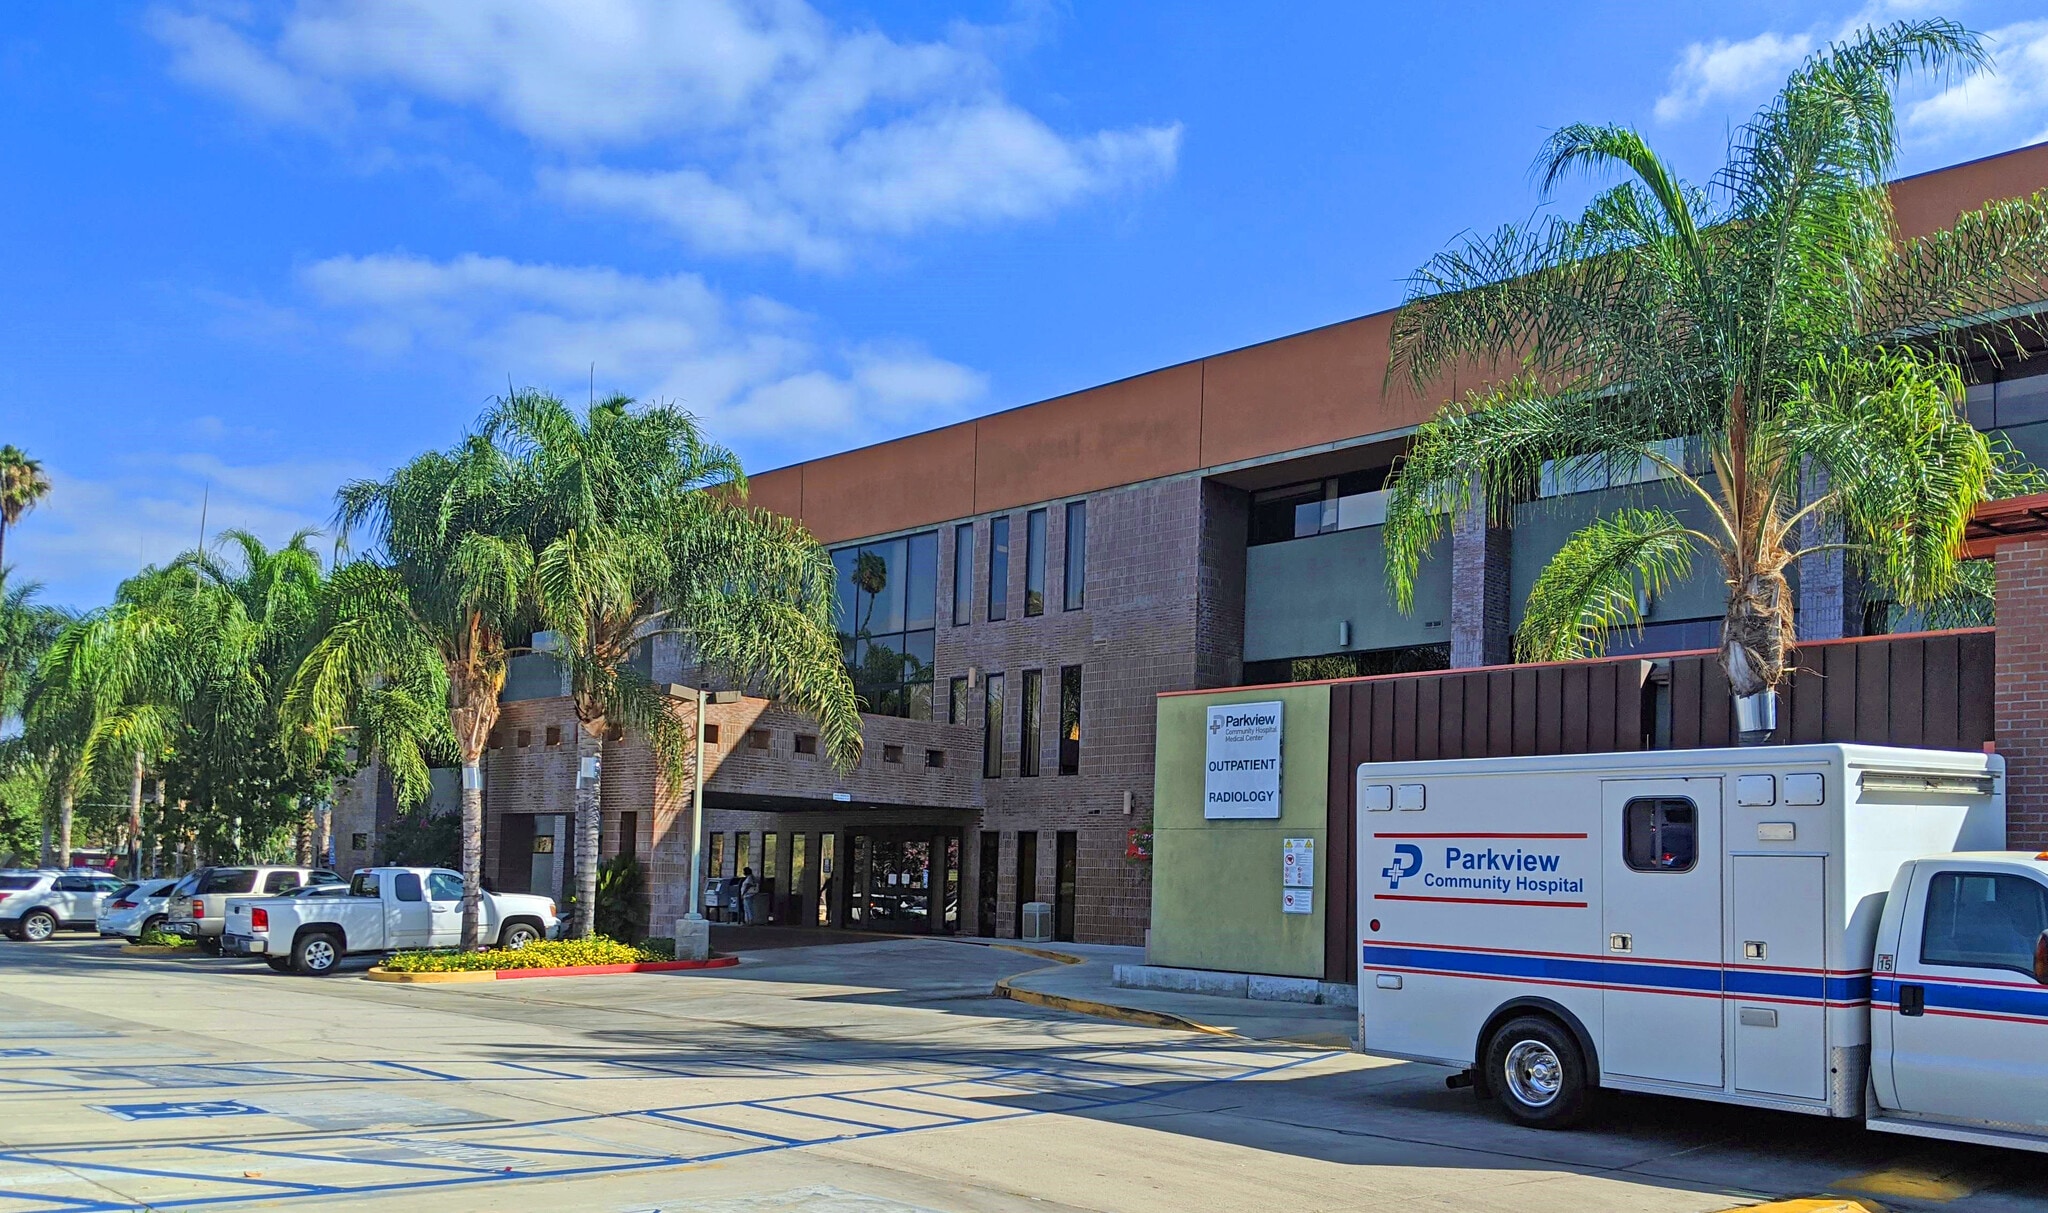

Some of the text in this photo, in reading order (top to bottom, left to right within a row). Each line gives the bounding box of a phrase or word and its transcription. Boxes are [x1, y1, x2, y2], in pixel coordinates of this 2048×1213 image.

[1226, 713, 1275, 727] Parkview
[1225, 726, 1278, 736] Community Hospital
[1225, 734, 1264, 743] Medical Center
[1209, 759, 1276, 772] OUTPATIENT
[1209, 791, 1274, 802] RADIOLOGY
[1446, 846, 1561, 872] Parkview
[1424, 872, 1584, 895] Community Hospital
[1880, 960, 1890, 970] 15
